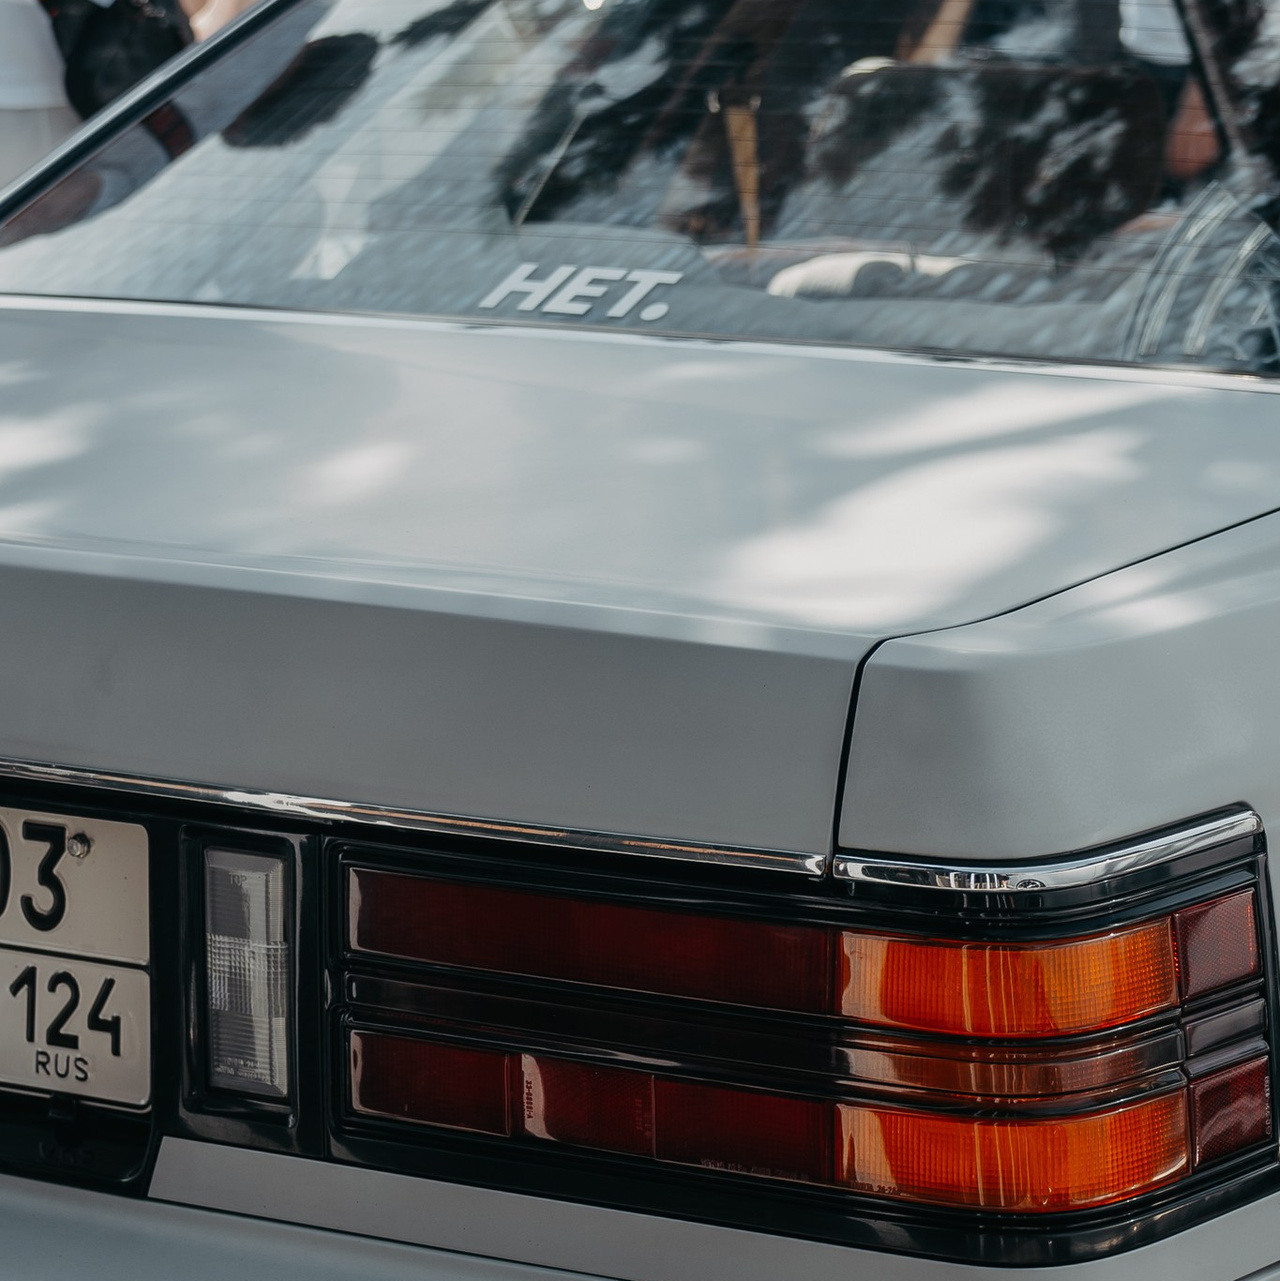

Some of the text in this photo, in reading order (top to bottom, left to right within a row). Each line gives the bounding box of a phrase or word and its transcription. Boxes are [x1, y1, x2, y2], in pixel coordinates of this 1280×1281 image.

[0, 818, 67, 932] 3
[9, 965, 121, 1057] 124
[36, 1050, 89, 1082] RUS
